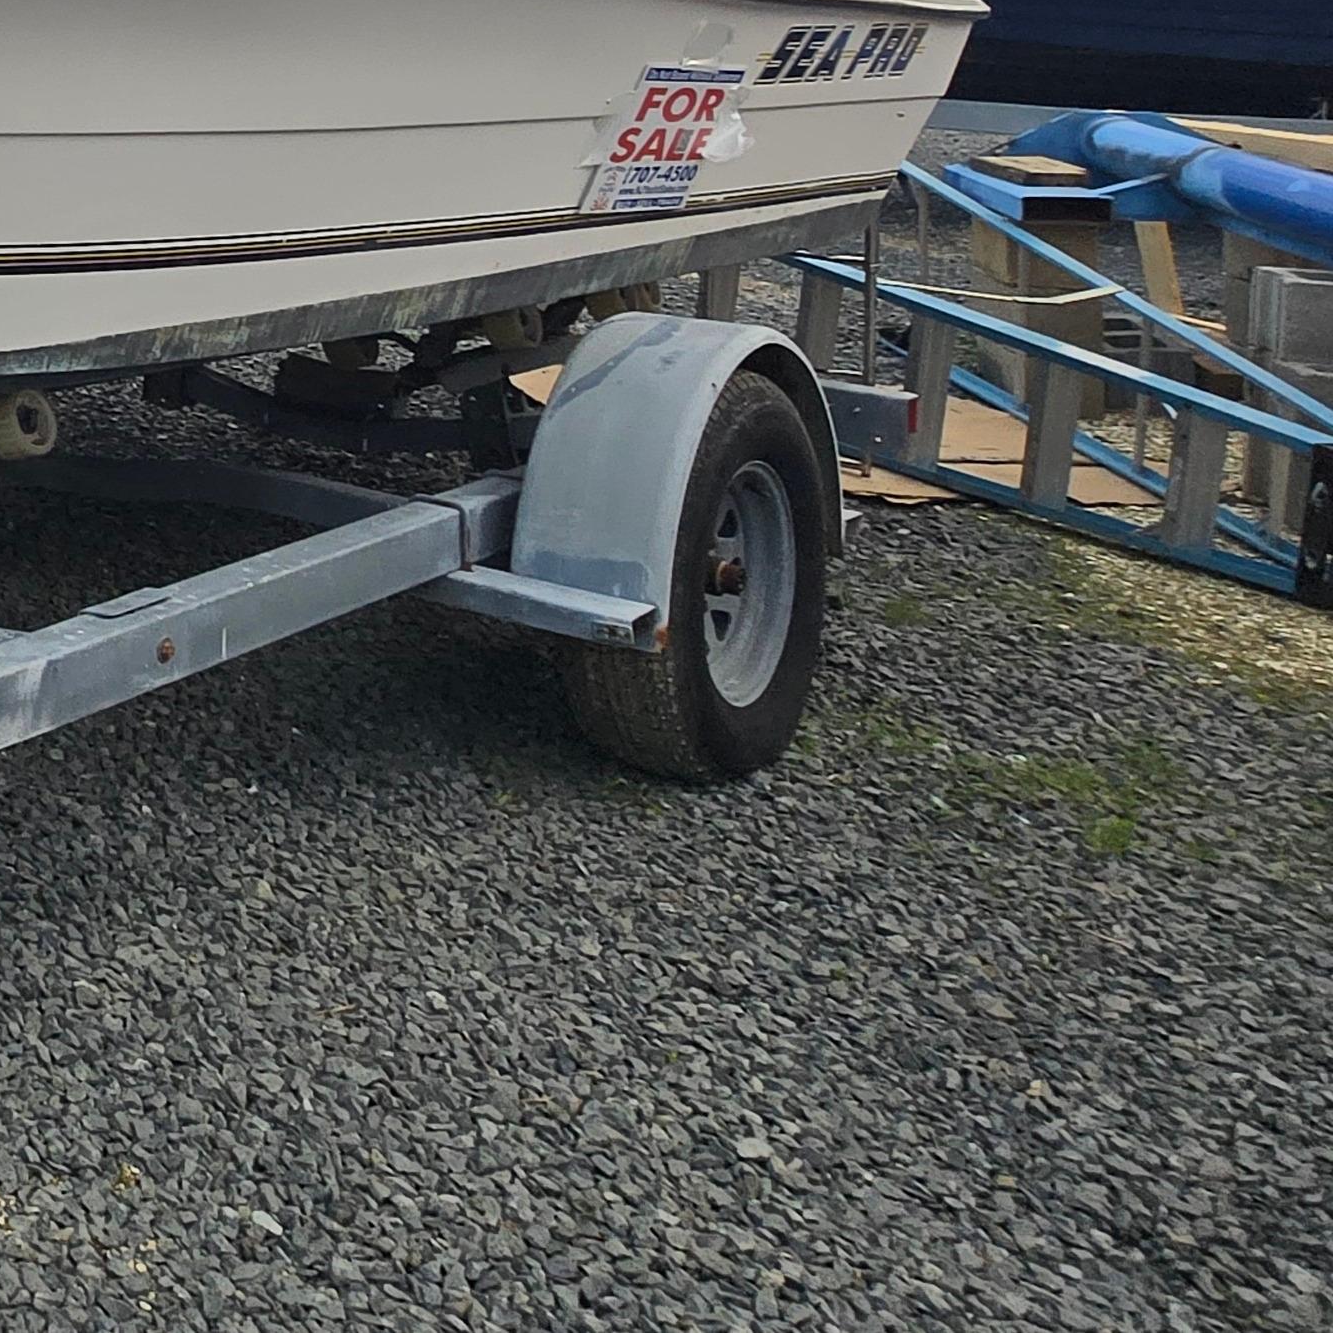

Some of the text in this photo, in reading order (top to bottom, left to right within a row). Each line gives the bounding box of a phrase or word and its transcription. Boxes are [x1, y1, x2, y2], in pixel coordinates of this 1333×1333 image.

[753, 22, 930, 85] SEA PRO
[634, 87, 725, 123] FOR
[609, 127, 714, 163] SALE
